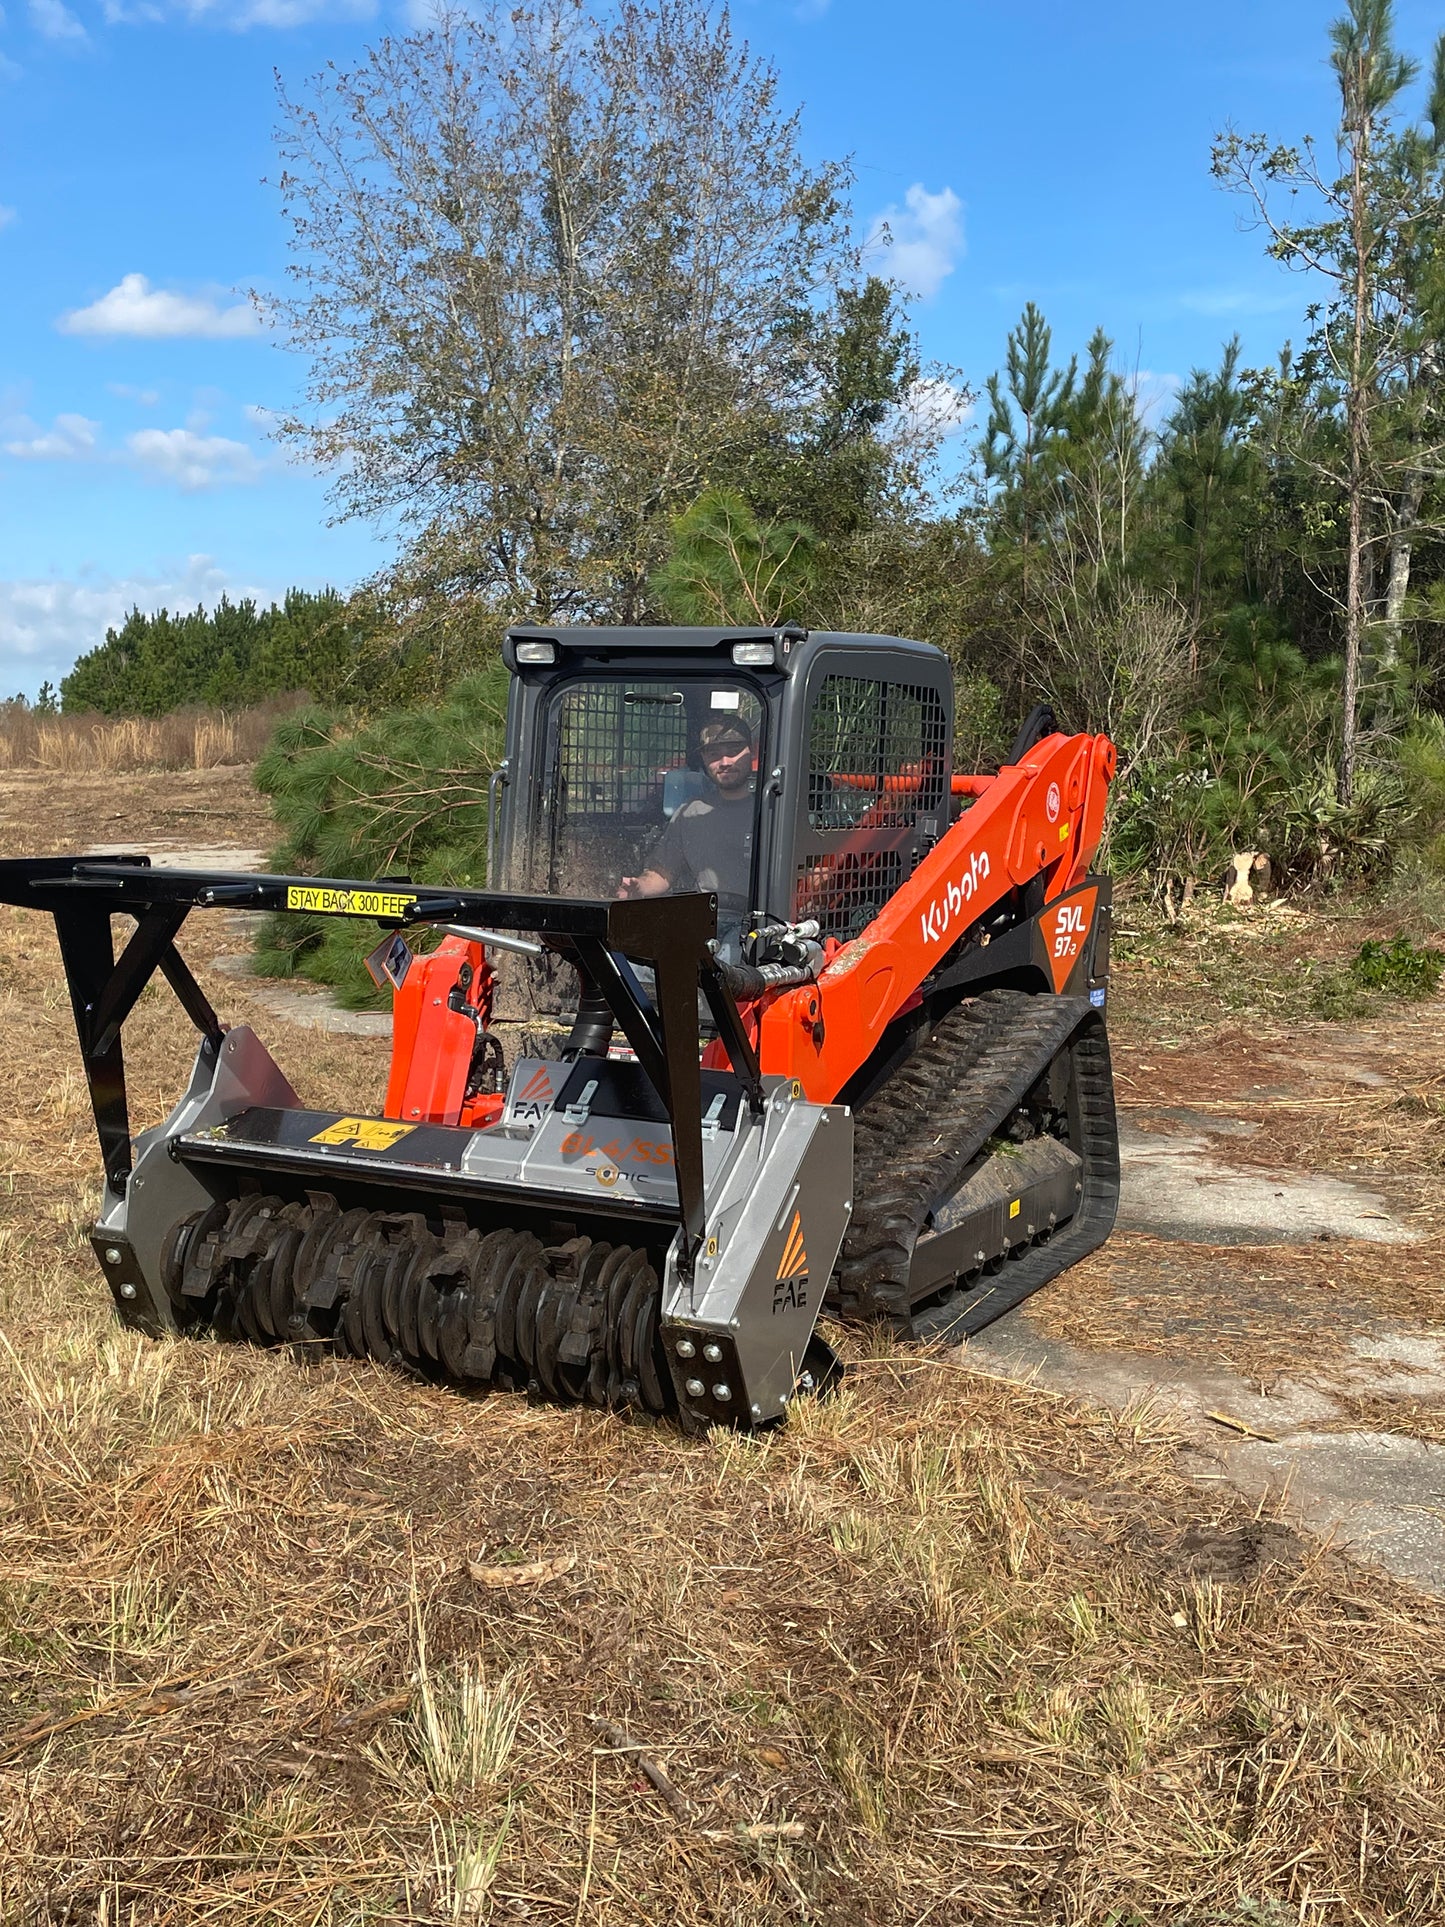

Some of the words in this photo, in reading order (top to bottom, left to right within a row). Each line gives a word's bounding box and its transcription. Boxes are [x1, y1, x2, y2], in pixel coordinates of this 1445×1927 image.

[290, 889, 320, 908] STAY
[322, 892, 356, 911] BACK
[359, 894, 379, 912] 300
[921, 851, 991, 944] Kubota
[1055, 905, 1086, 934] SVL
[1054, 936, 1077, 958] 97-2
[560, 1133, 676, 1166] BL4/SS
